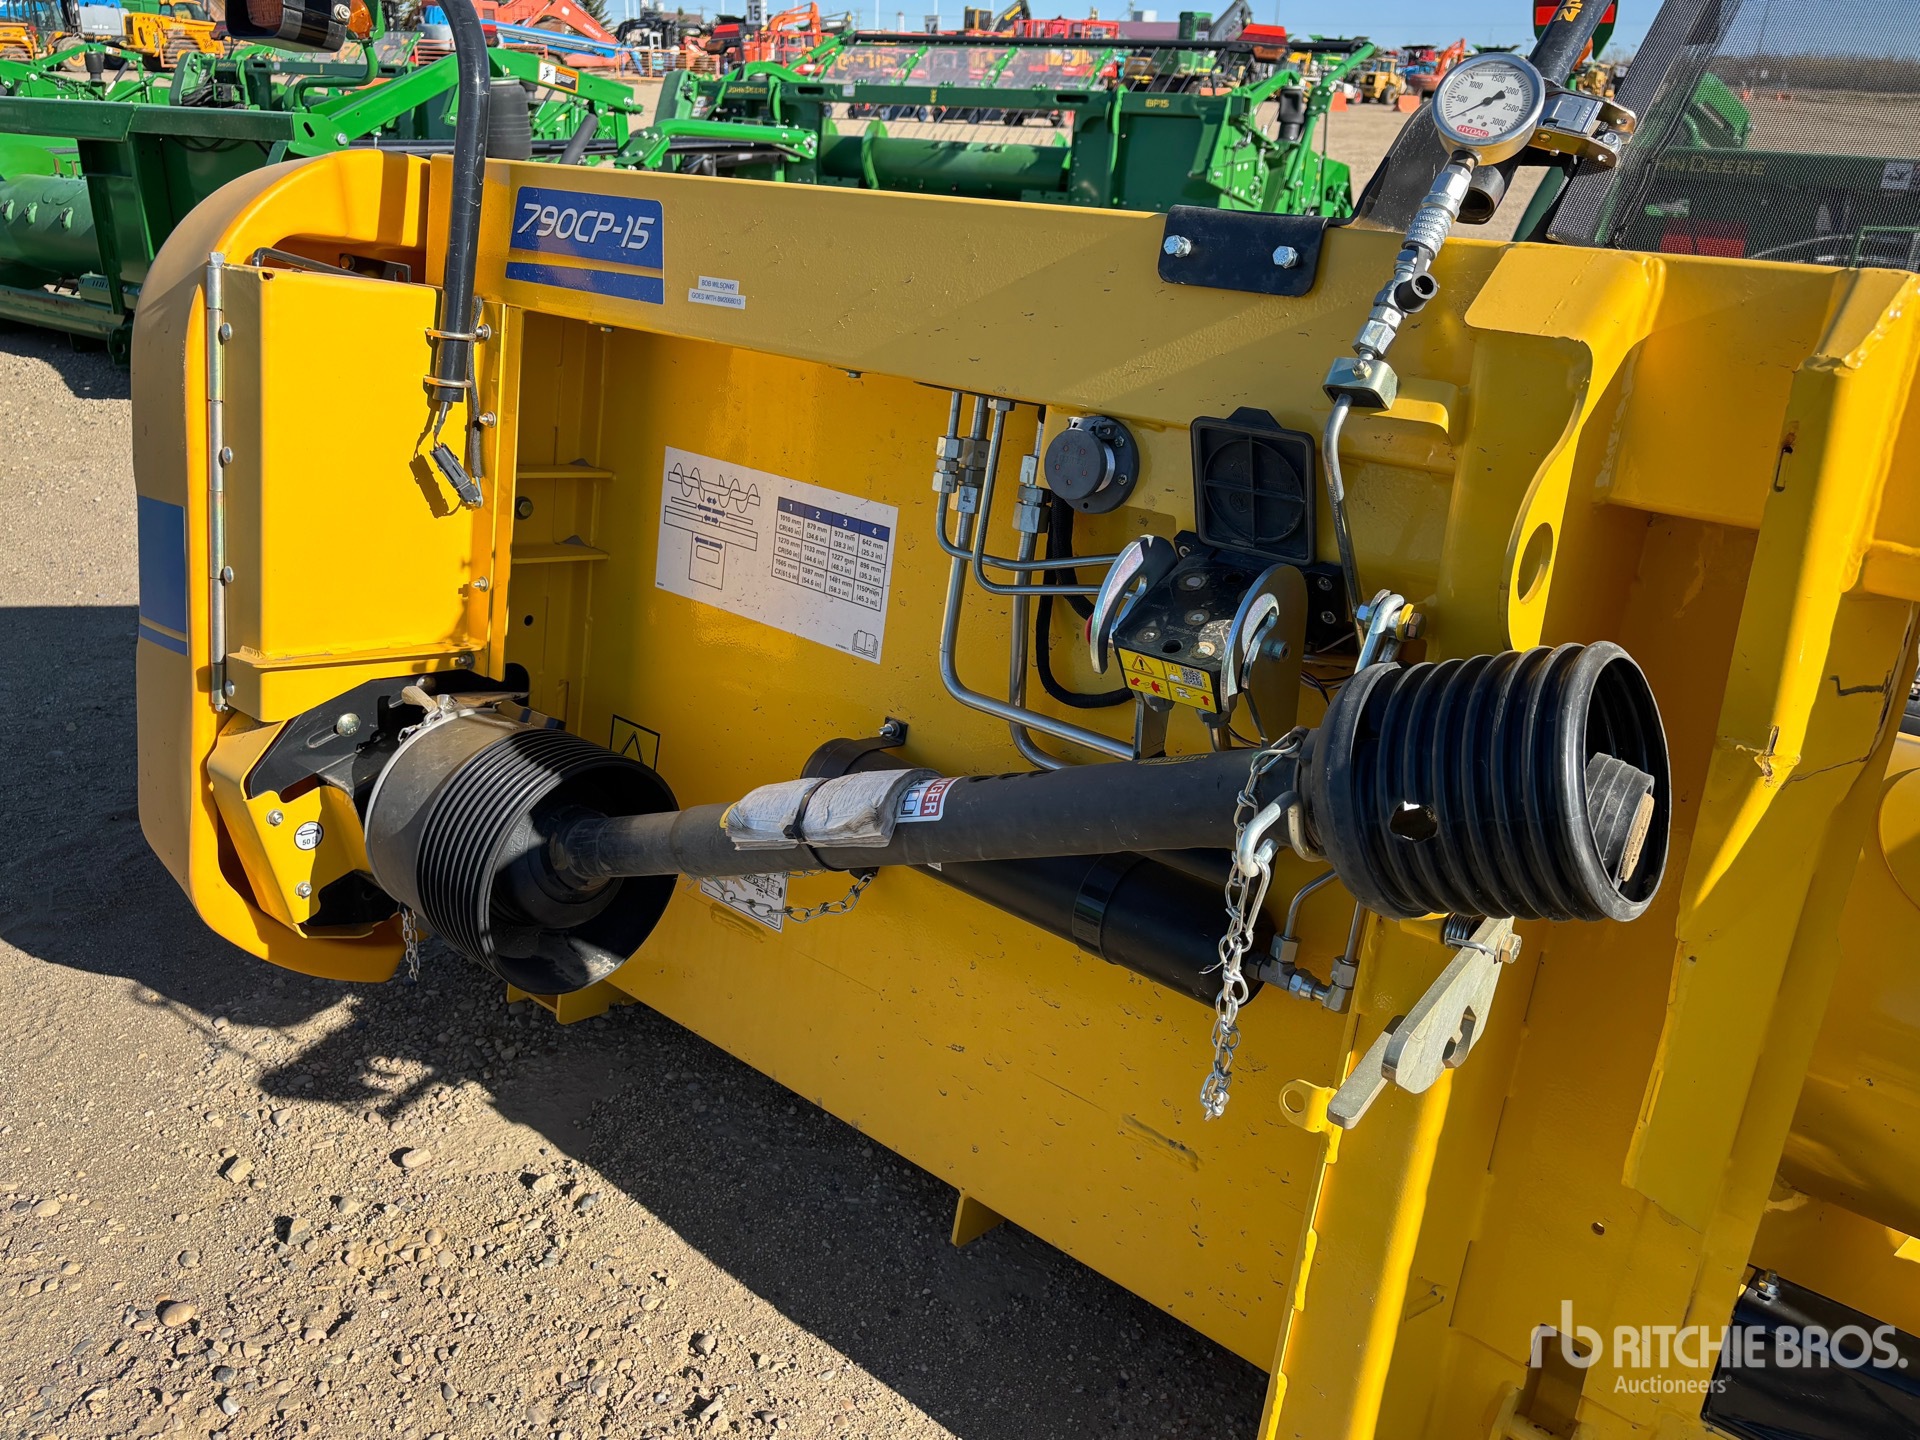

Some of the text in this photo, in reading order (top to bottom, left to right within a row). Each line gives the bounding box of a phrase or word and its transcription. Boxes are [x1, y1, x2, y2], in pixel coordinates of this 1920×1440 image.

[747, 5, 761, 21] 15
[1491, 74, 1506, 83] 1500
[1469, 80, 1484, 90] 1000
[1503, 86, 1520, 96] 2000
[1455, 94, 1468, 104] 500
[1502, 103, 1520, 113] 2500
[1490, 117, 1507, 127] 3000
[1458, 125, 1489, 138] HYDAC
[517, 202, 655, 250] 790CP-15
[701, 279, 711, 287] BOB
[691, 292, 704, 300] GOES
[705, 294, 717, 302] WITH
[789, 503, 793, 511] 1
[815, 511, 821, 519] 2
[791, 518, 802, 526] mm
[842, 518, 848, 527] 3
[806, 522, 827, 534] 879 mm
[871, 527, 877, 535] 4
[844, 534, 856, 542] mm
[846, 543, 855, 553] in)
[862, 538, 884, 550] 642 mm
[816, 549, 826, 557] mm
[861, 548, 874, 558] (25.3
[787, 563, 798, 571] mm
[870, 565, 882, 574] mm
[813, 571, 825, 579] mm
[872, 575, 880, 584] in)
[841, 580, 853, 588] mm
[841, 589, 849, 598] in)
